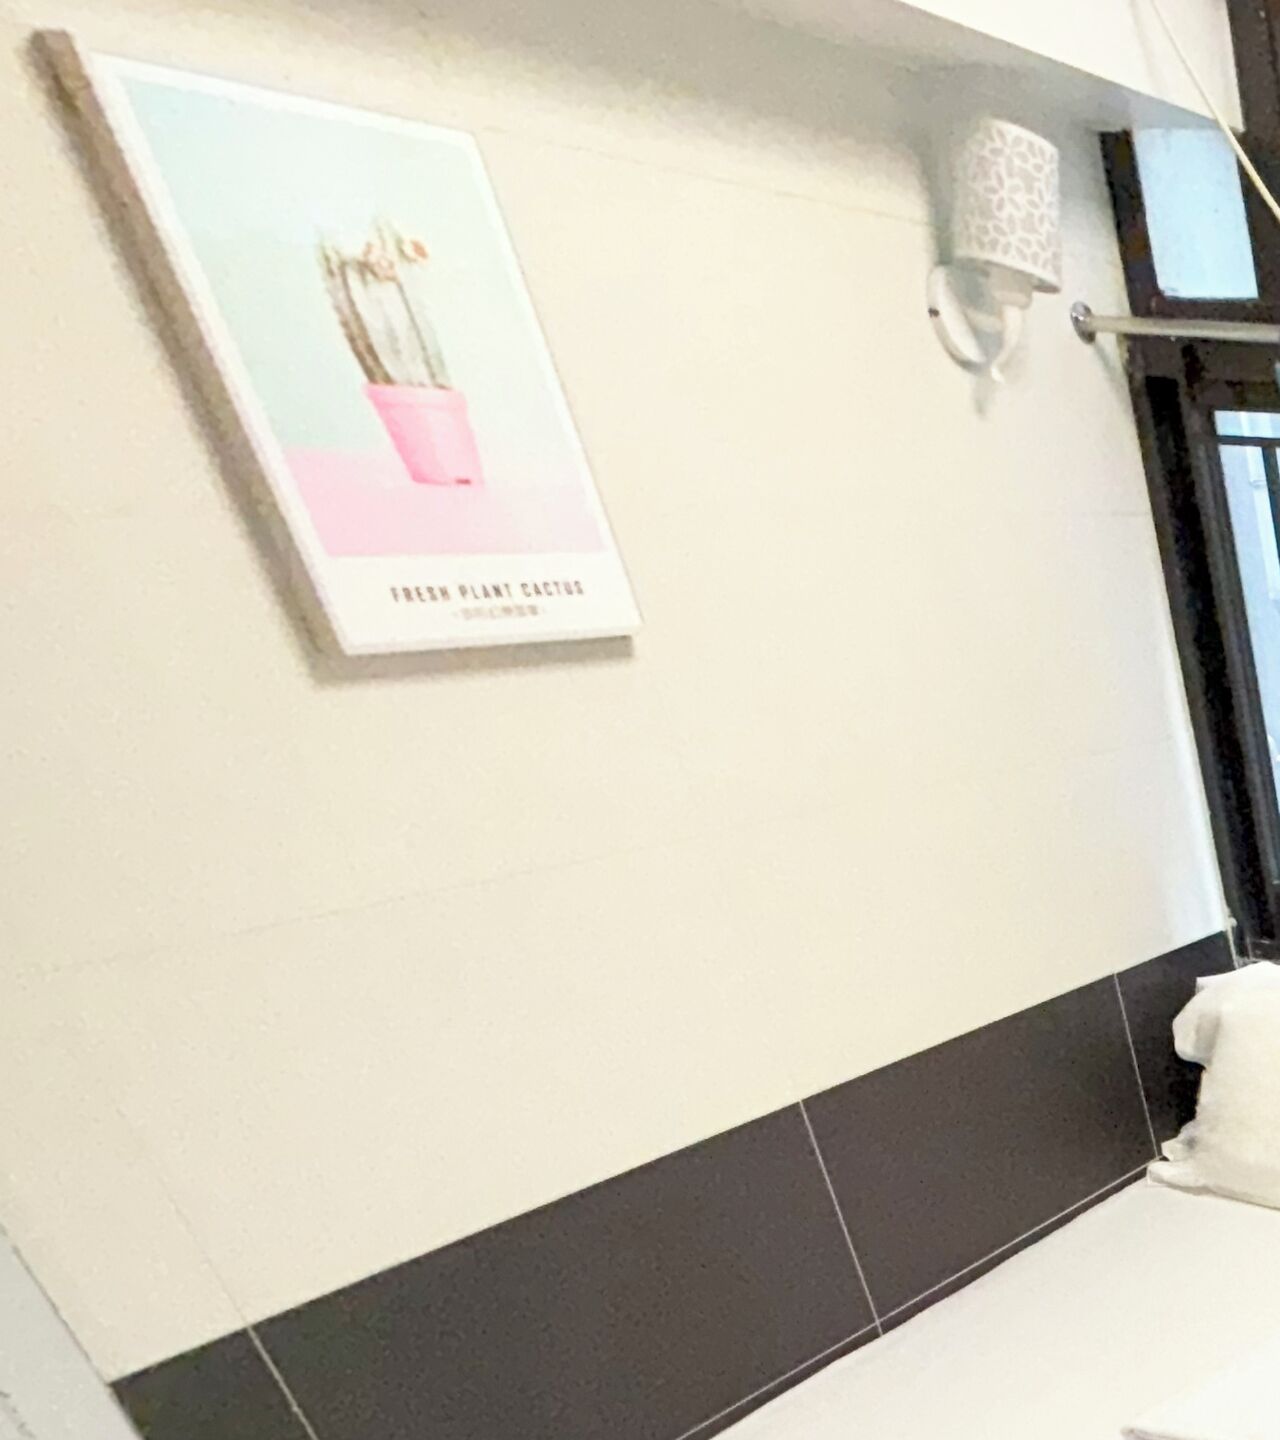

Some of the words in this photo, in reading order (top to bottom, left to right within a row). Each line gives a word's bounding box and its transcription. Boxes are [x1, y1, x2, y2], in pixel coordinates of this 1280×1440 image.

[390, 585, 450, 602] FRESH
[458, 582, 513, 600] PLANT
[520, 580, 584, 598] CACTUS
